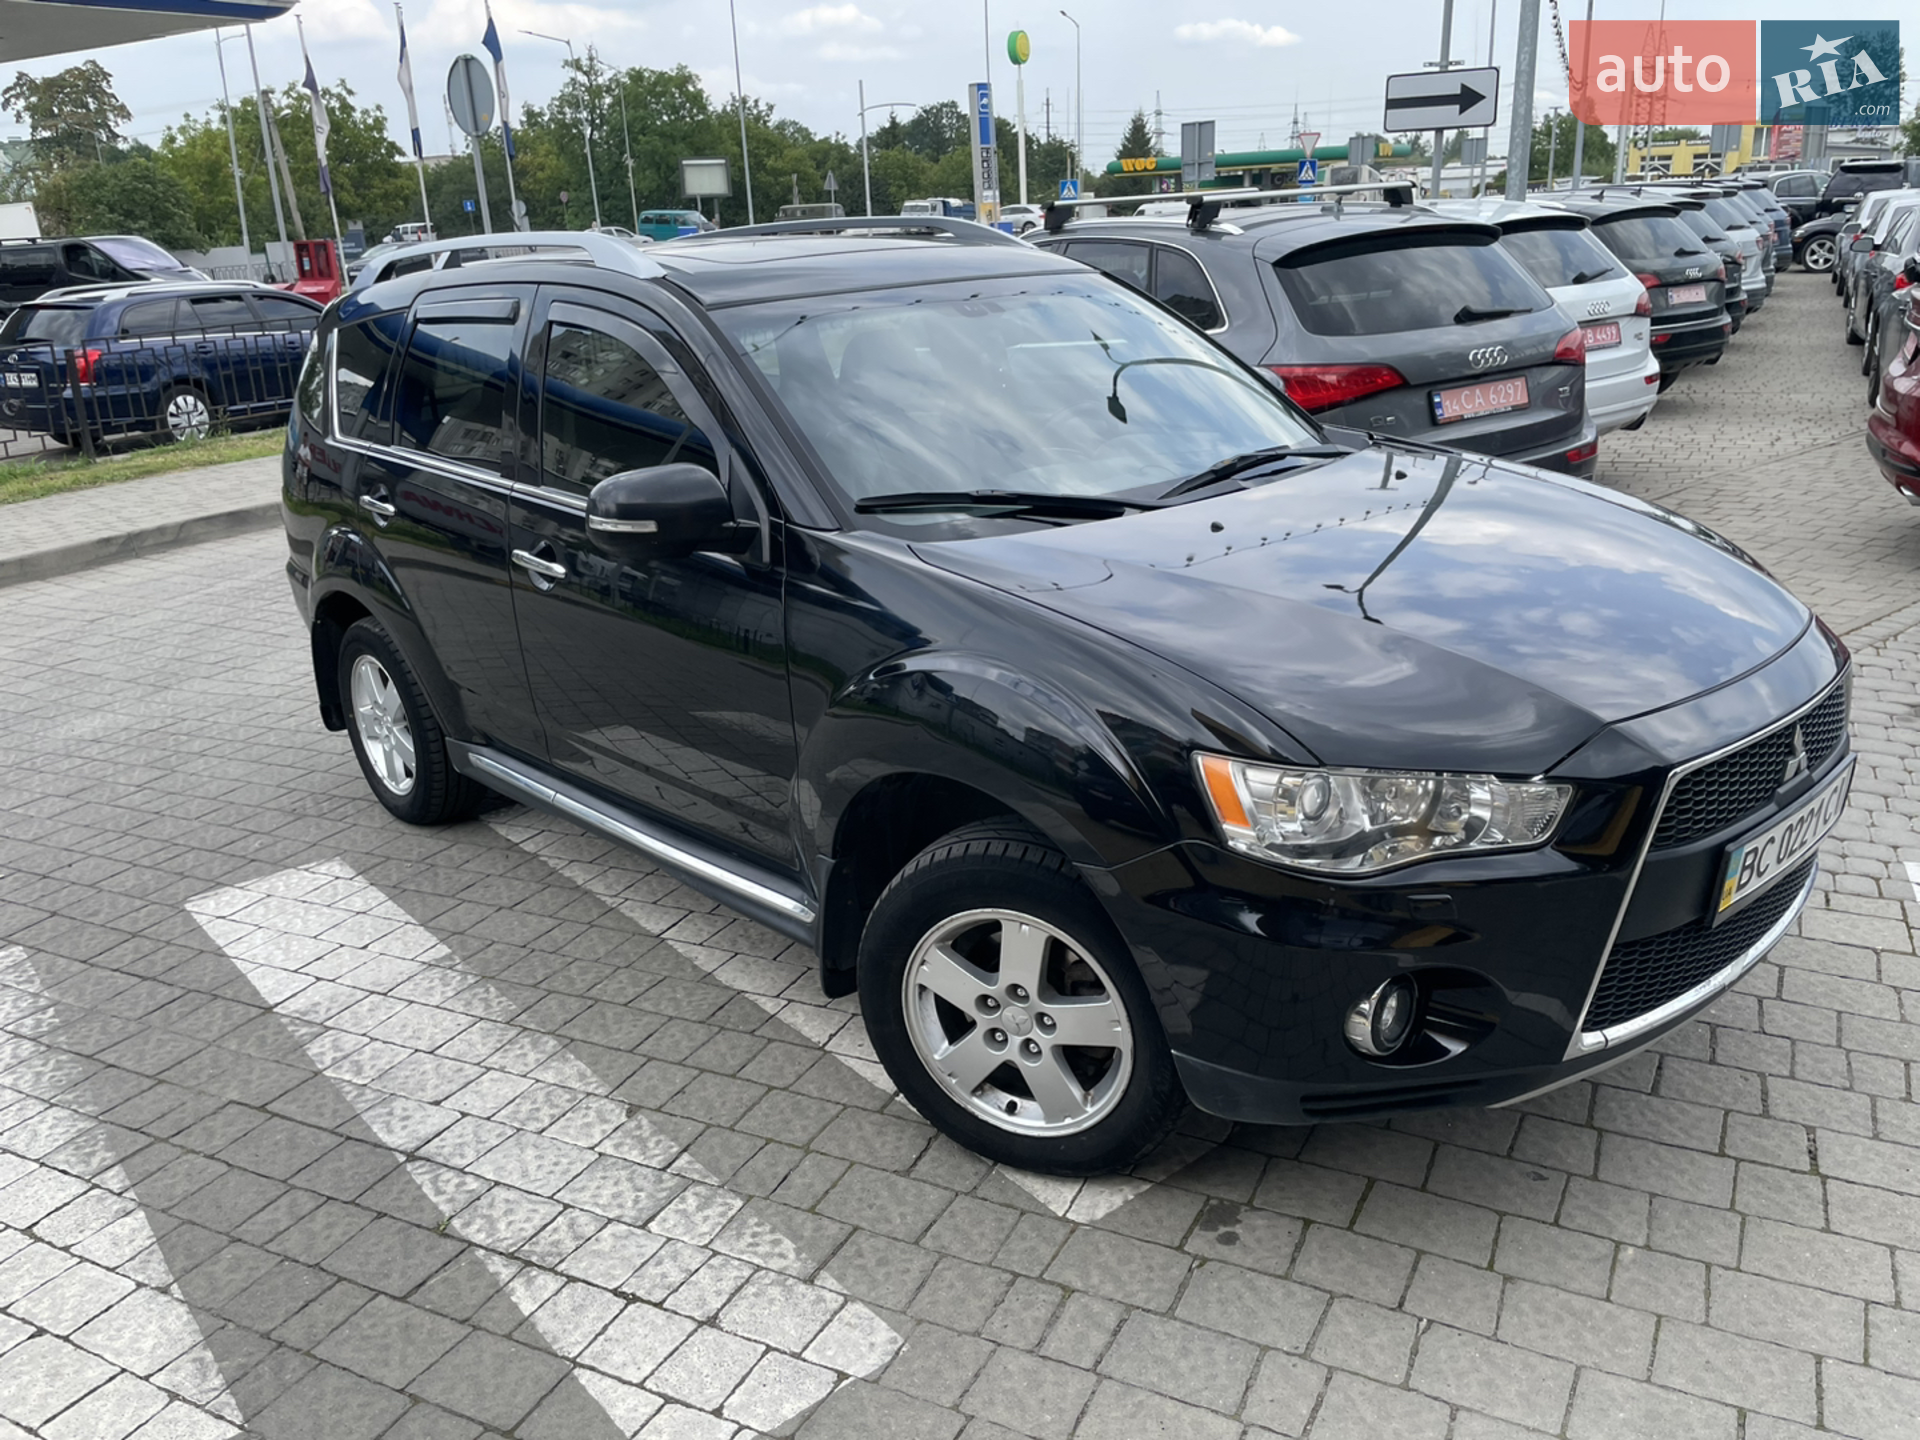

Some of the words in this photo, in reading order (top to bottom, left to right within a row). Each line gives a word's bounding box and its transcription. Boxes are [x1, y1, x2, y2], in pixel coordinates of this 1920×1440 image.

[1121, 157, 1157, 172] WOG
[1489, 381, 1522, 405] 6297
[1735, 835, 1776, 894] BC
[1777, 795, 1825, 866] 0221
